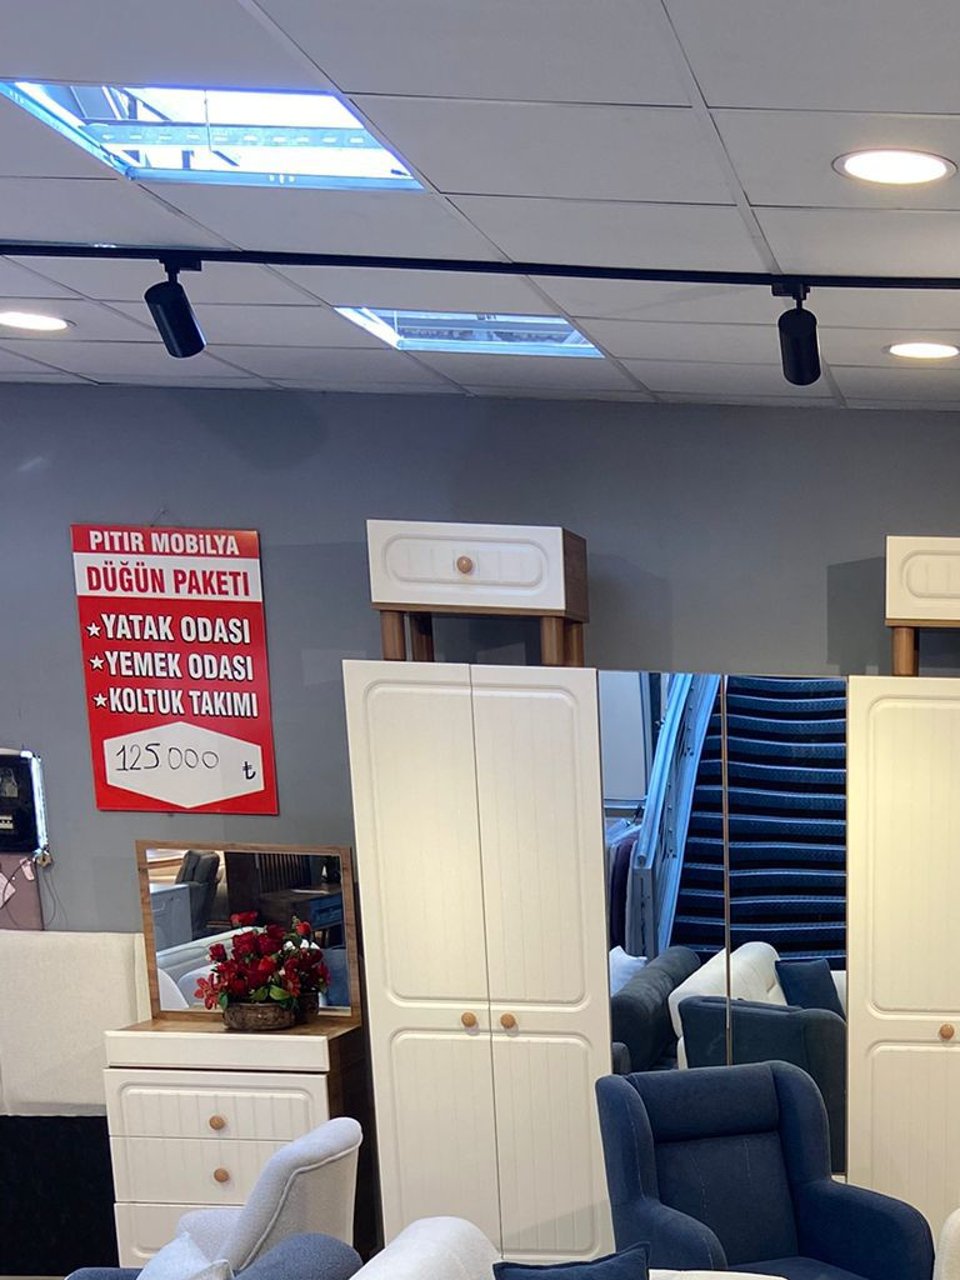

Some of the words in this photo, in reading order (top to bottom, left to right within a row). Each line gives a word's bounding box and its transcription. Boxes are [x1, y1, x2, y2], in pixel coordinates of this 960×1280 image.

[90, 530, 145, 553] PITIR
[86, 560, 165, 594] DÜĞÜN
[101, 614, 175, 641] YATAK
[181, 616, 250, 644] ODASI
[104, 651, 182, 679] YEMEK
[189, 654, 254, 681] ODASI
[109, 687, 184, 715] KOLTUK
[189, 690, 258, 718] TAKIMI
